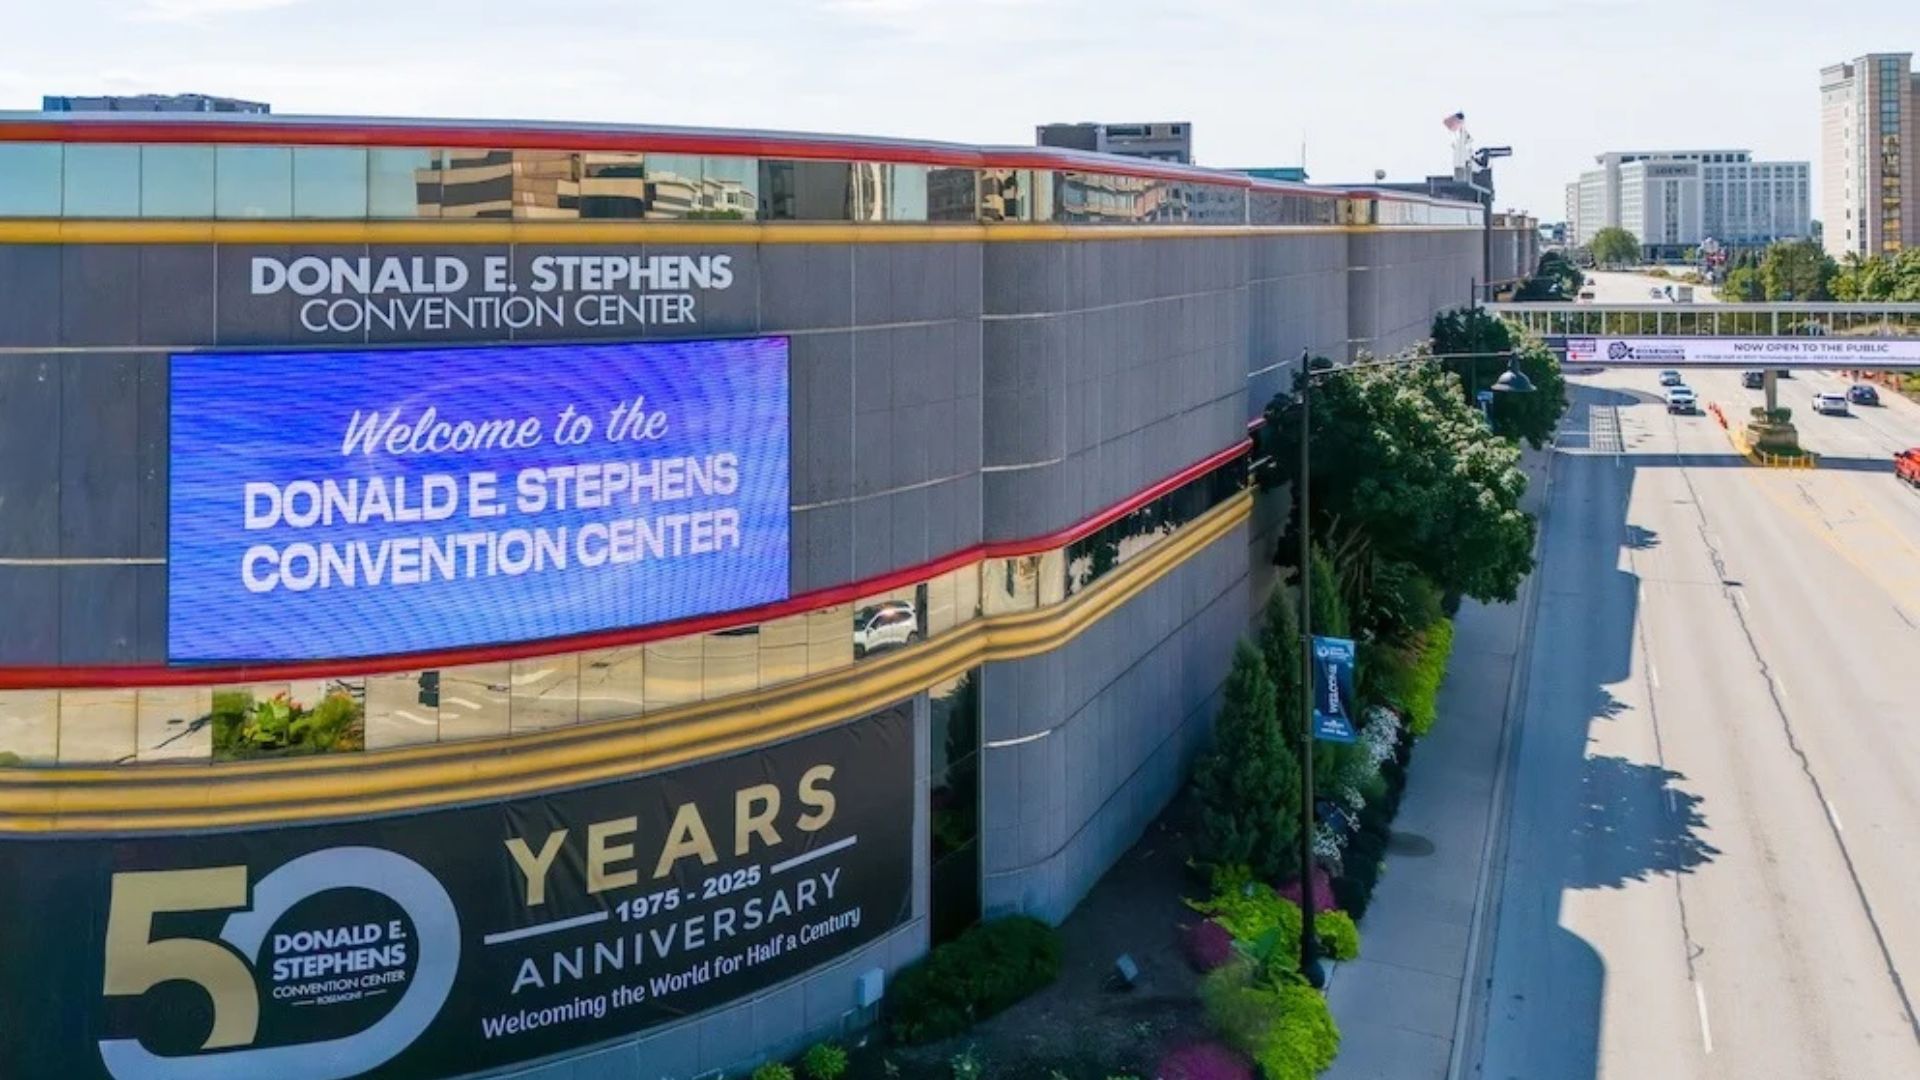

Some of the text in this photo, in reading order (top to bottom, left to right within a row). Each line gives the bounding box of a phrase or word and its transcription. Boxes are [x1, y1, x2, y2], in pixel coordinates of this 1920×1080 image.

[251, 255, 733, 295] DONALD E. STEPHENS
[300, 294, 697, 333] CONVENTION CENTER
[1734, 343, 1889, 352] NOW OPEN TO THE PUBLIC
[341, 395, 668, 456] Welcome to the
[244, 453, 739, 530] DONALD E. STEPHENS
[241, 509, 740, 594] CONVENTION CENTER
[1328, 664, 1339, 713] WELCOME
[504, 764, 837, 907] YEARS
[615, 888, 680, 923] 1975
[702, 864, 762, 901] 2025
[273, 920, 407, 955] DONALD E.
[511, 867, 842, 995] ANNIVERSARY
[98, 845, 461, 1080] 50
[272, 943, 407, 981] STEPHENS
[272, 970, 406, 999] CONVENTION CENTER
[481, 905, 862, 1040] Welcoming the World for Half a Century
[317, 990, 363, 1005] ROSEMONT
